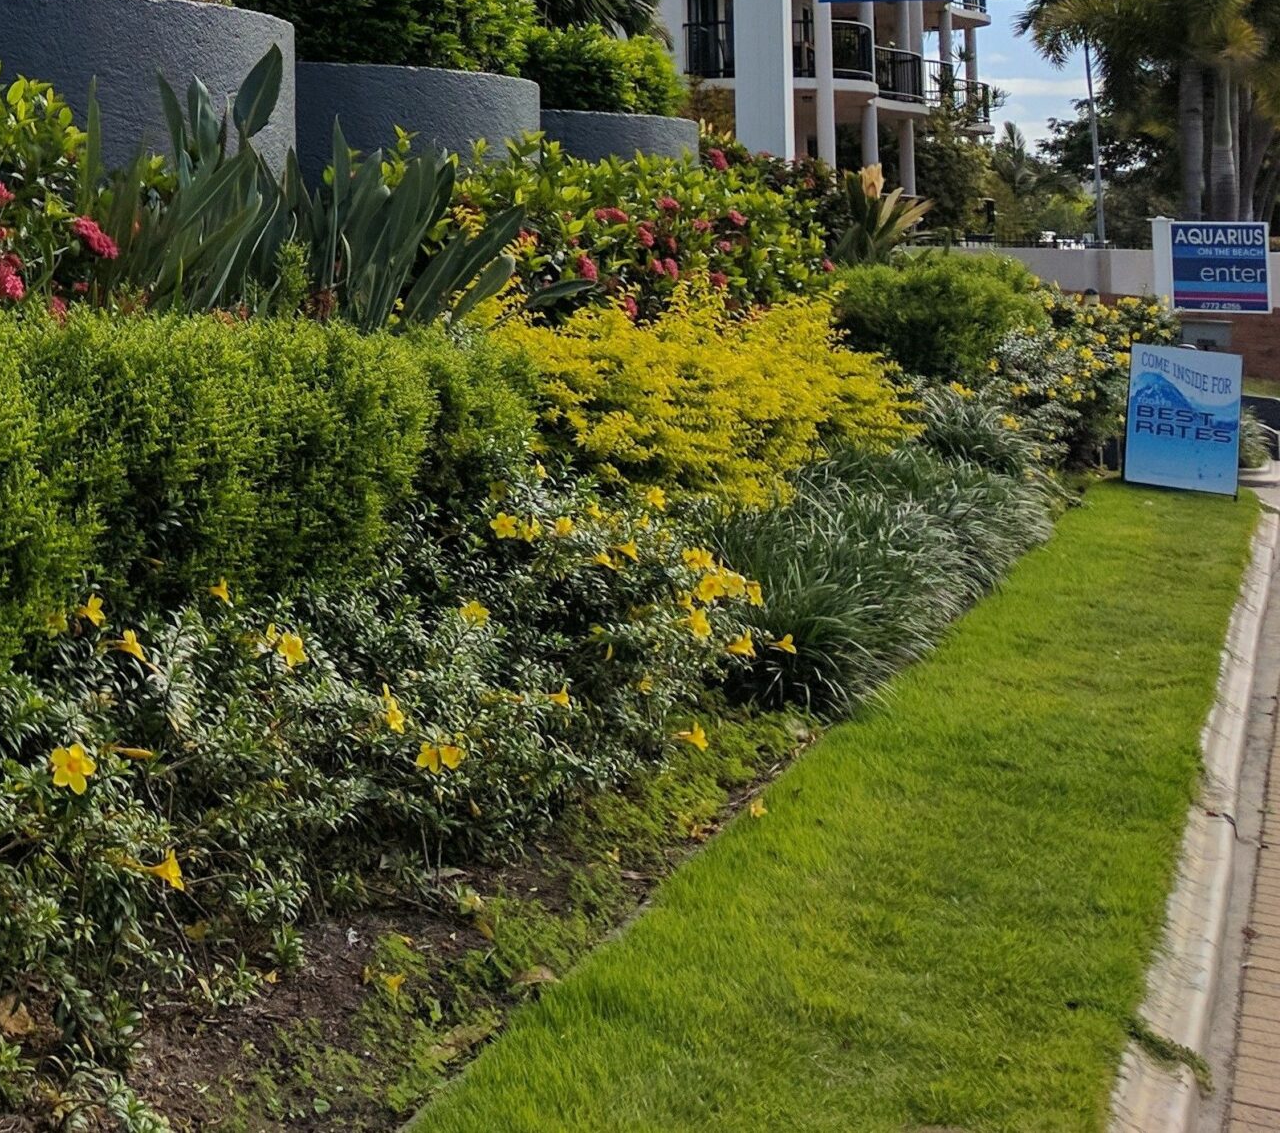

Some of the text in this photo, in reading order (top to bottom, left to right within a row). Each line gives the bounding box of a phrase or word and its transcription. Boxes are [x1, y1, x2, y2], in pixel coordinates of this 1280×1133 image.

[1174, 228, 1264, 246] AQUARIUS
[1197, 248, 1264, 257] ON THE BEACH
[1200, 265, 1266, 283] enter
[1141, 351, 1232, 395] COME INSIDE FOR
[1136, 404, 1215, 426] BEST
[1135, 420, 1232, 444] RATES
